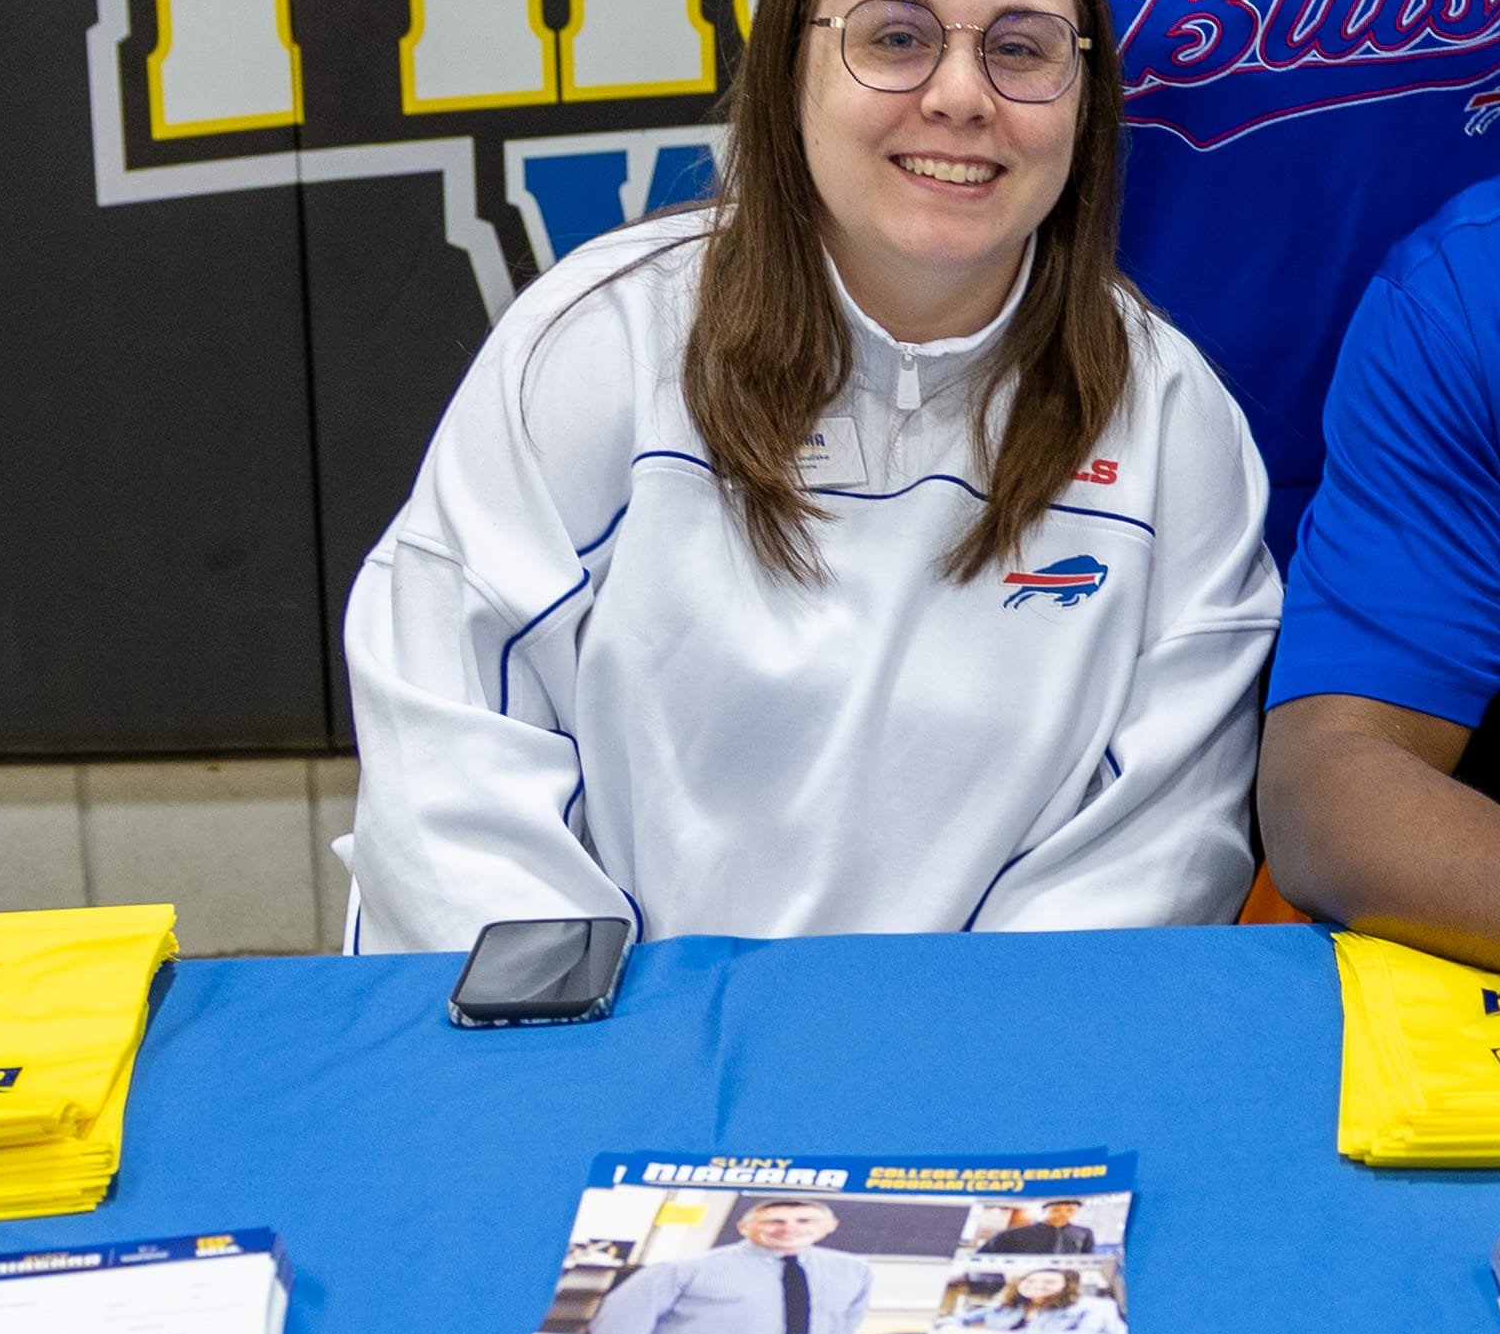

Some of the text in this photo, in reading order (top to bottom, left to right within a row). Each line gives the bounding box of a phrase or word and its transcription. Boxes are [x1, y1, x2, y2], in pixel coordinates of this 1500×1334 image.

[710, 1157, 793, 1168] SUNY
[643, 1162, 849, 1188] NIAGARA
[869, 1165, 1107, 1180] COLLEGE ACCELERATION
[865, 1178, 1024, 1192] PROGRAM (CAP)
